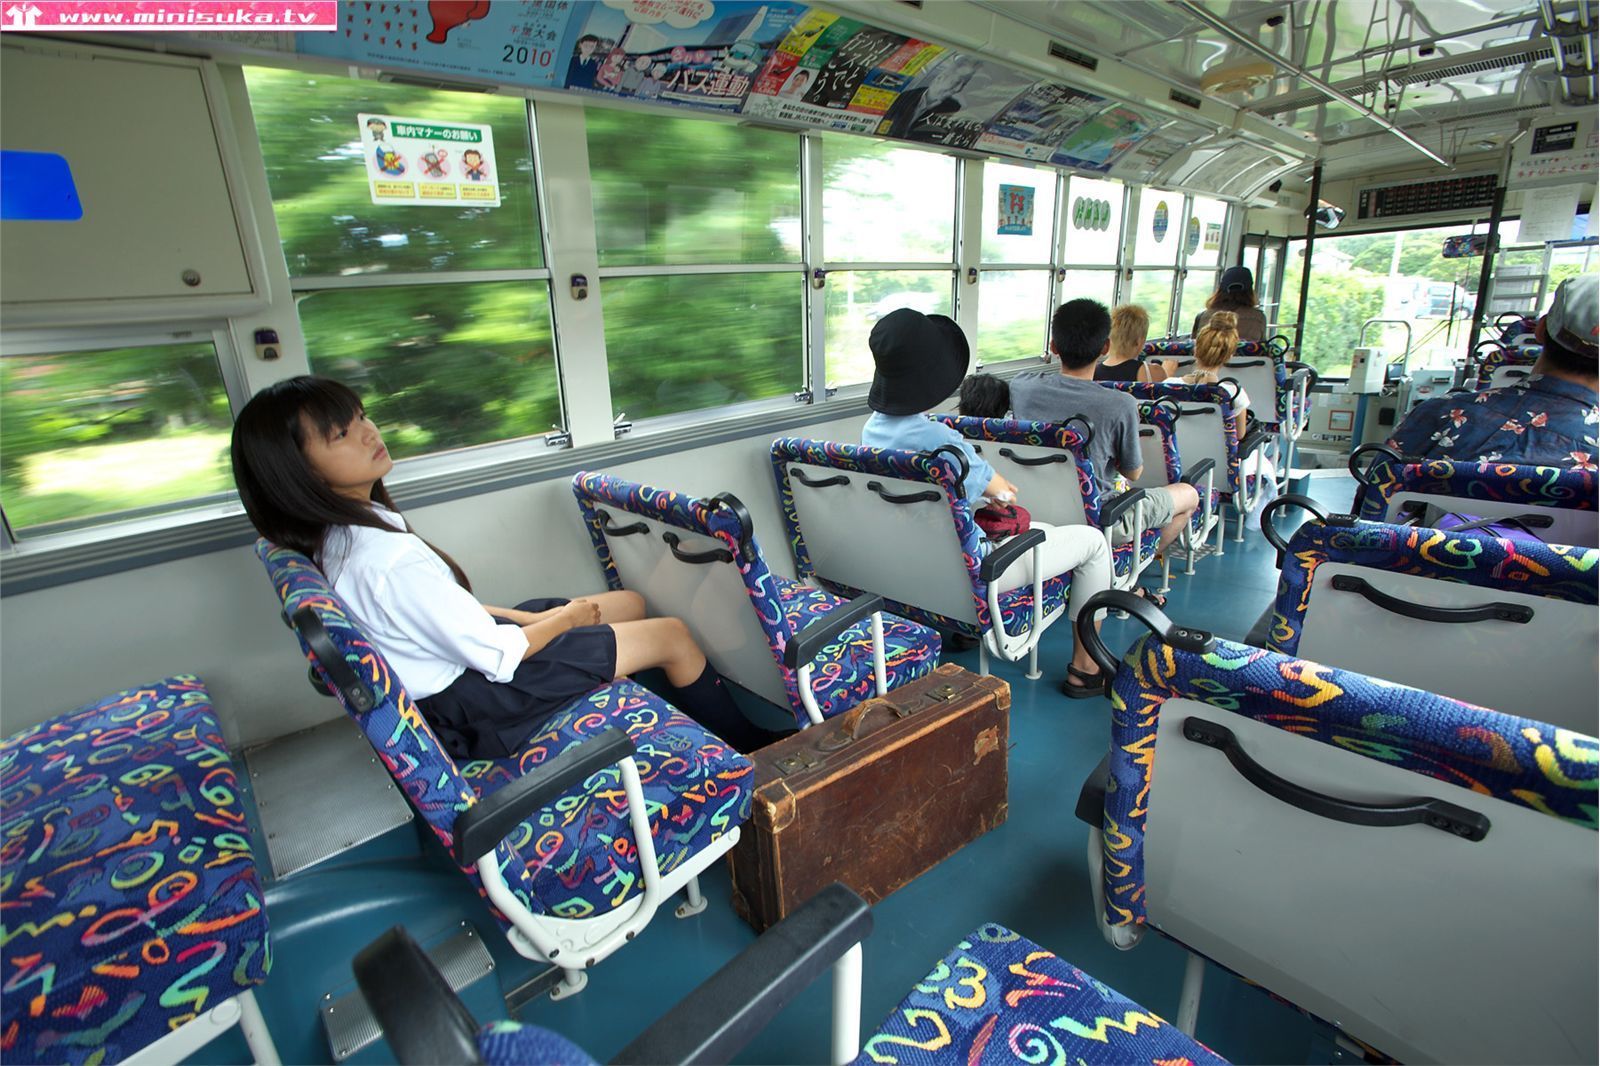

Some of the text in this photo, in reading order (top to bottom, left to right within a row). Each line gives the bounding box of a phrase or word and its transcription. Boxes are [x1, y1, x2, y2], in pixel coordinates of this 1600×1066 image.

[503, 44, 552, 68] 2010
[396, 125, 478, 141] 車内マナーのお願い
